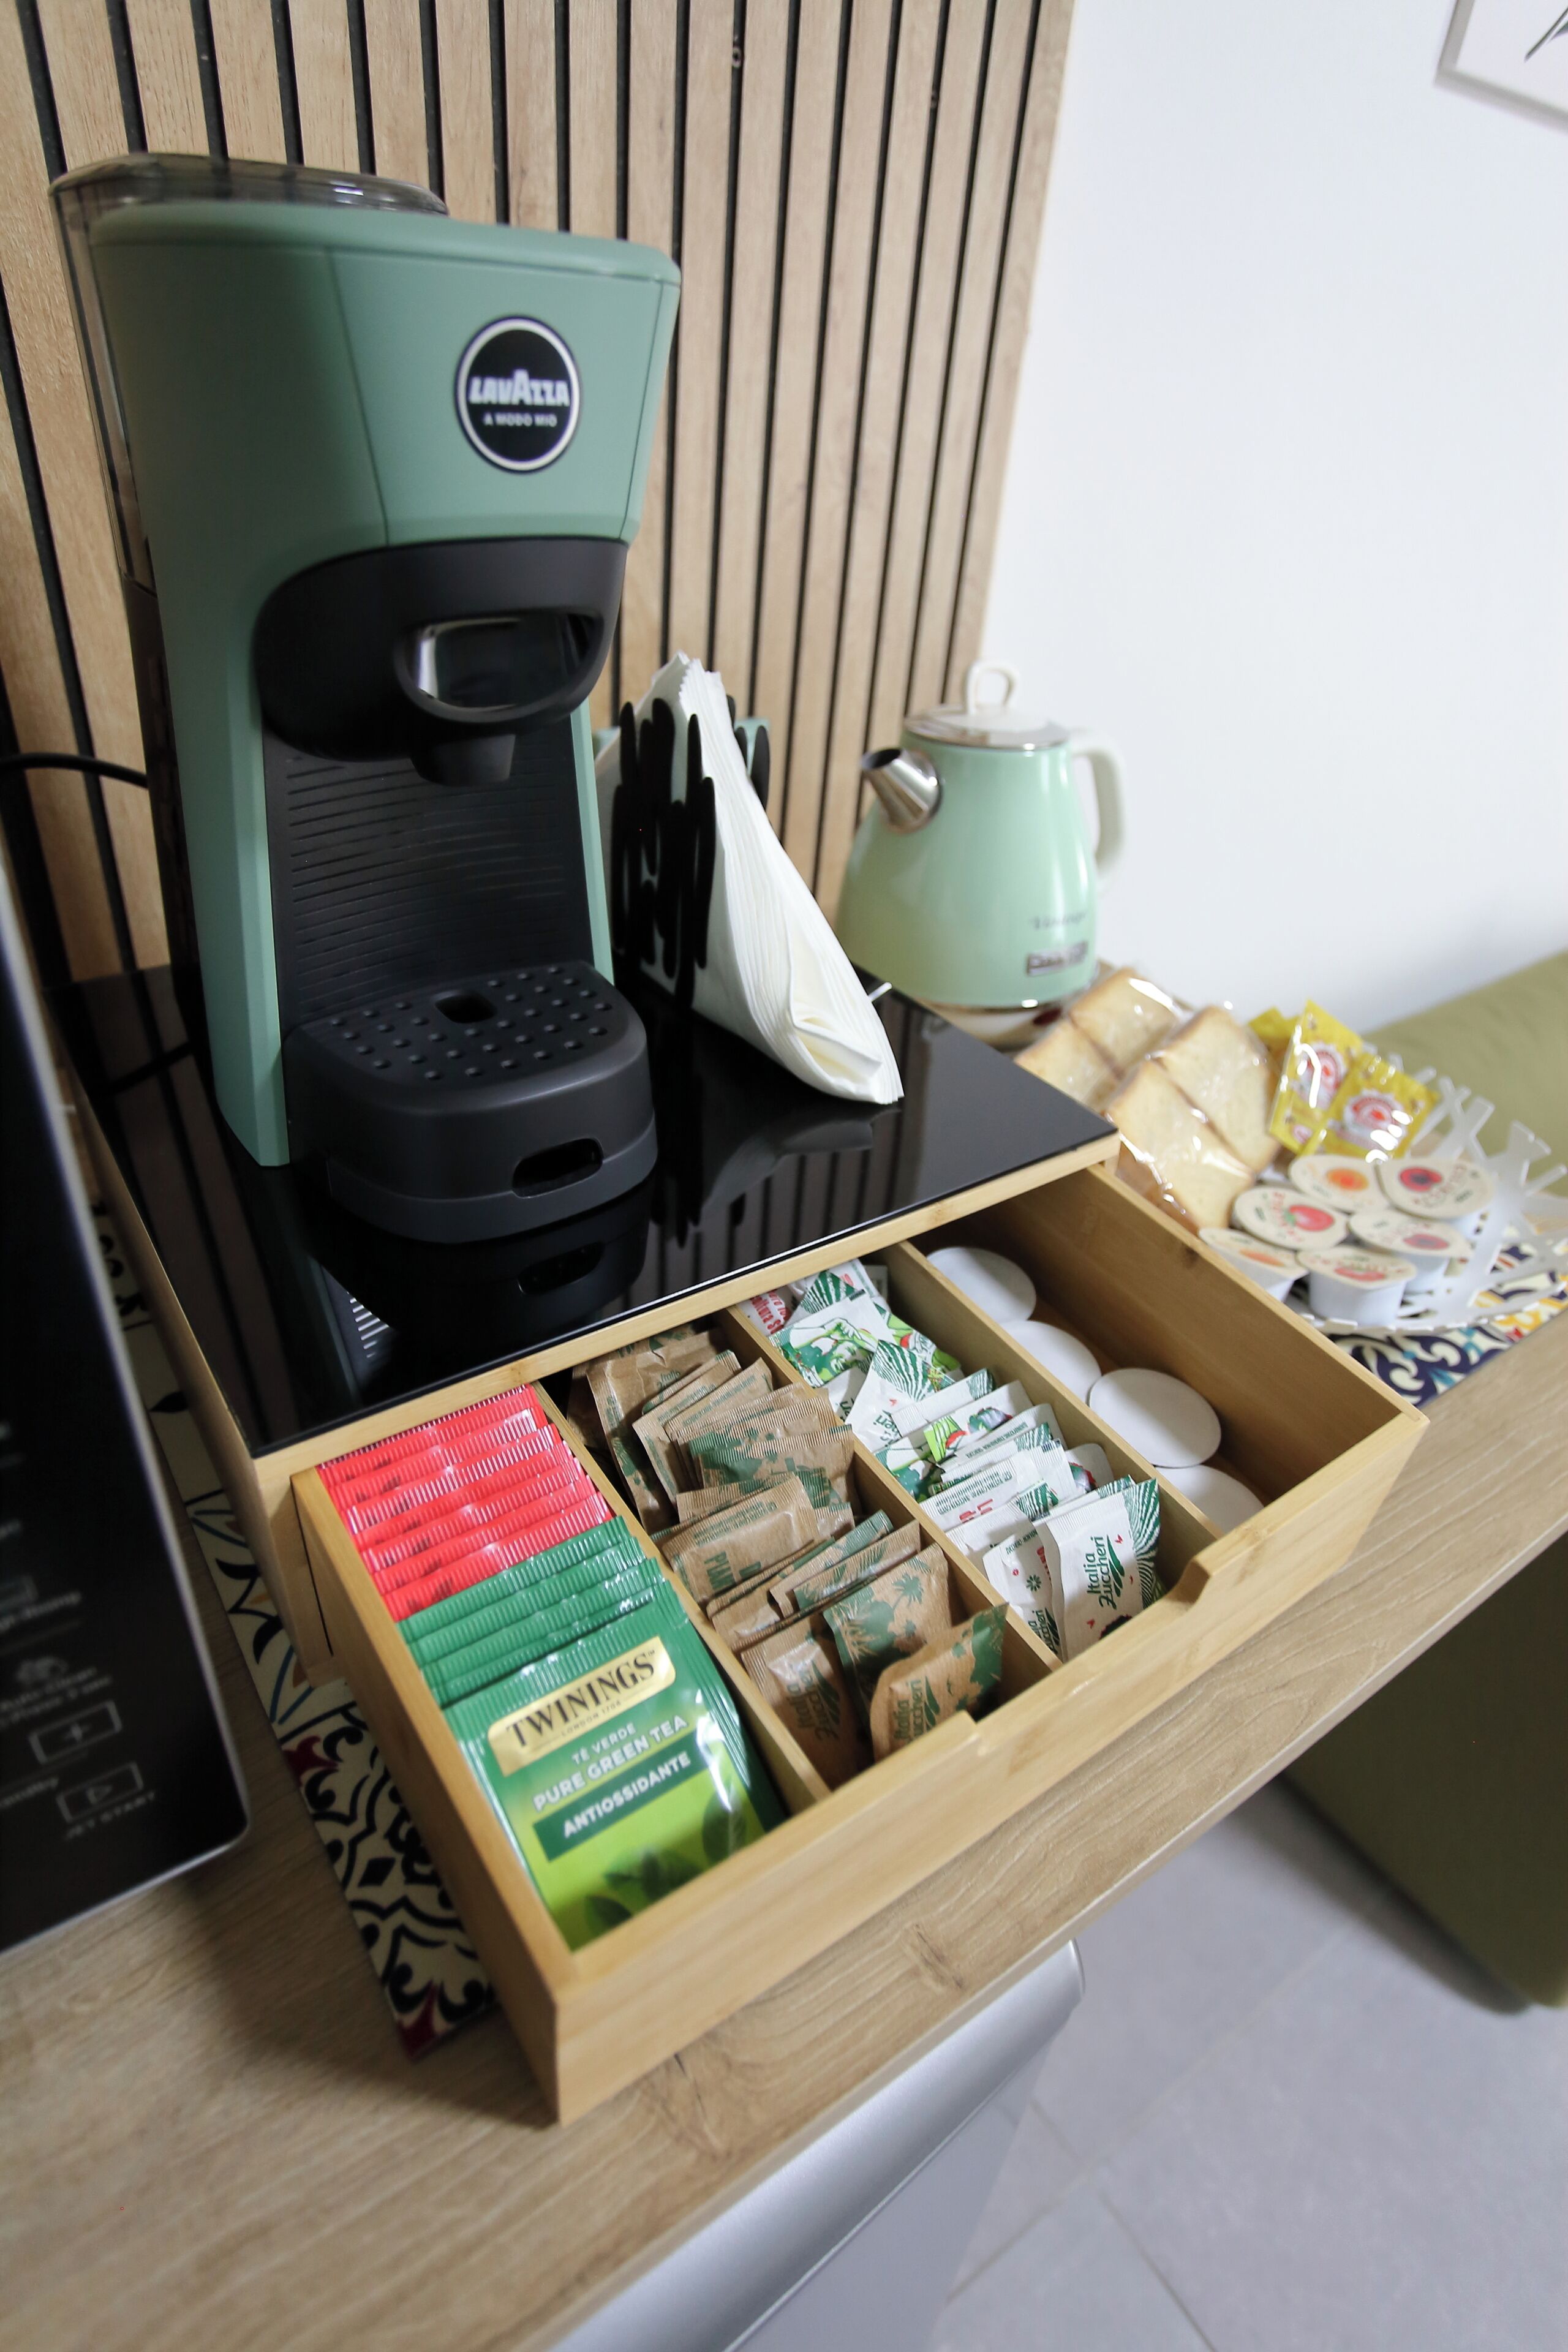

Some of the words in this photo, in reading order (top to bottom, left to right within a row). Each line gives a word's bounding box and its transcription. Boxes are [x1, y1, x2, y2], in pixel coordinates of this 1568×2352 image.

[469, 368, 570, 407] LAVAZZA
[1083, 1553, 1101, 1594] Italia
[1090, 1536, 1117, 1610] Zuccheri
[506, 1653, 654, 1746] TWININGS
[561, 1713, 600, 1737] LONDON
[533, 1771, 586, 1812] PURE
[587, 1734, 650, 1779] GREEN
[649, 1714, 688, 1743] TEA
[591, 1722, 636, 1754] VERDE
[564, 1750, 692, 1839] ANTIOSSIDANTE
